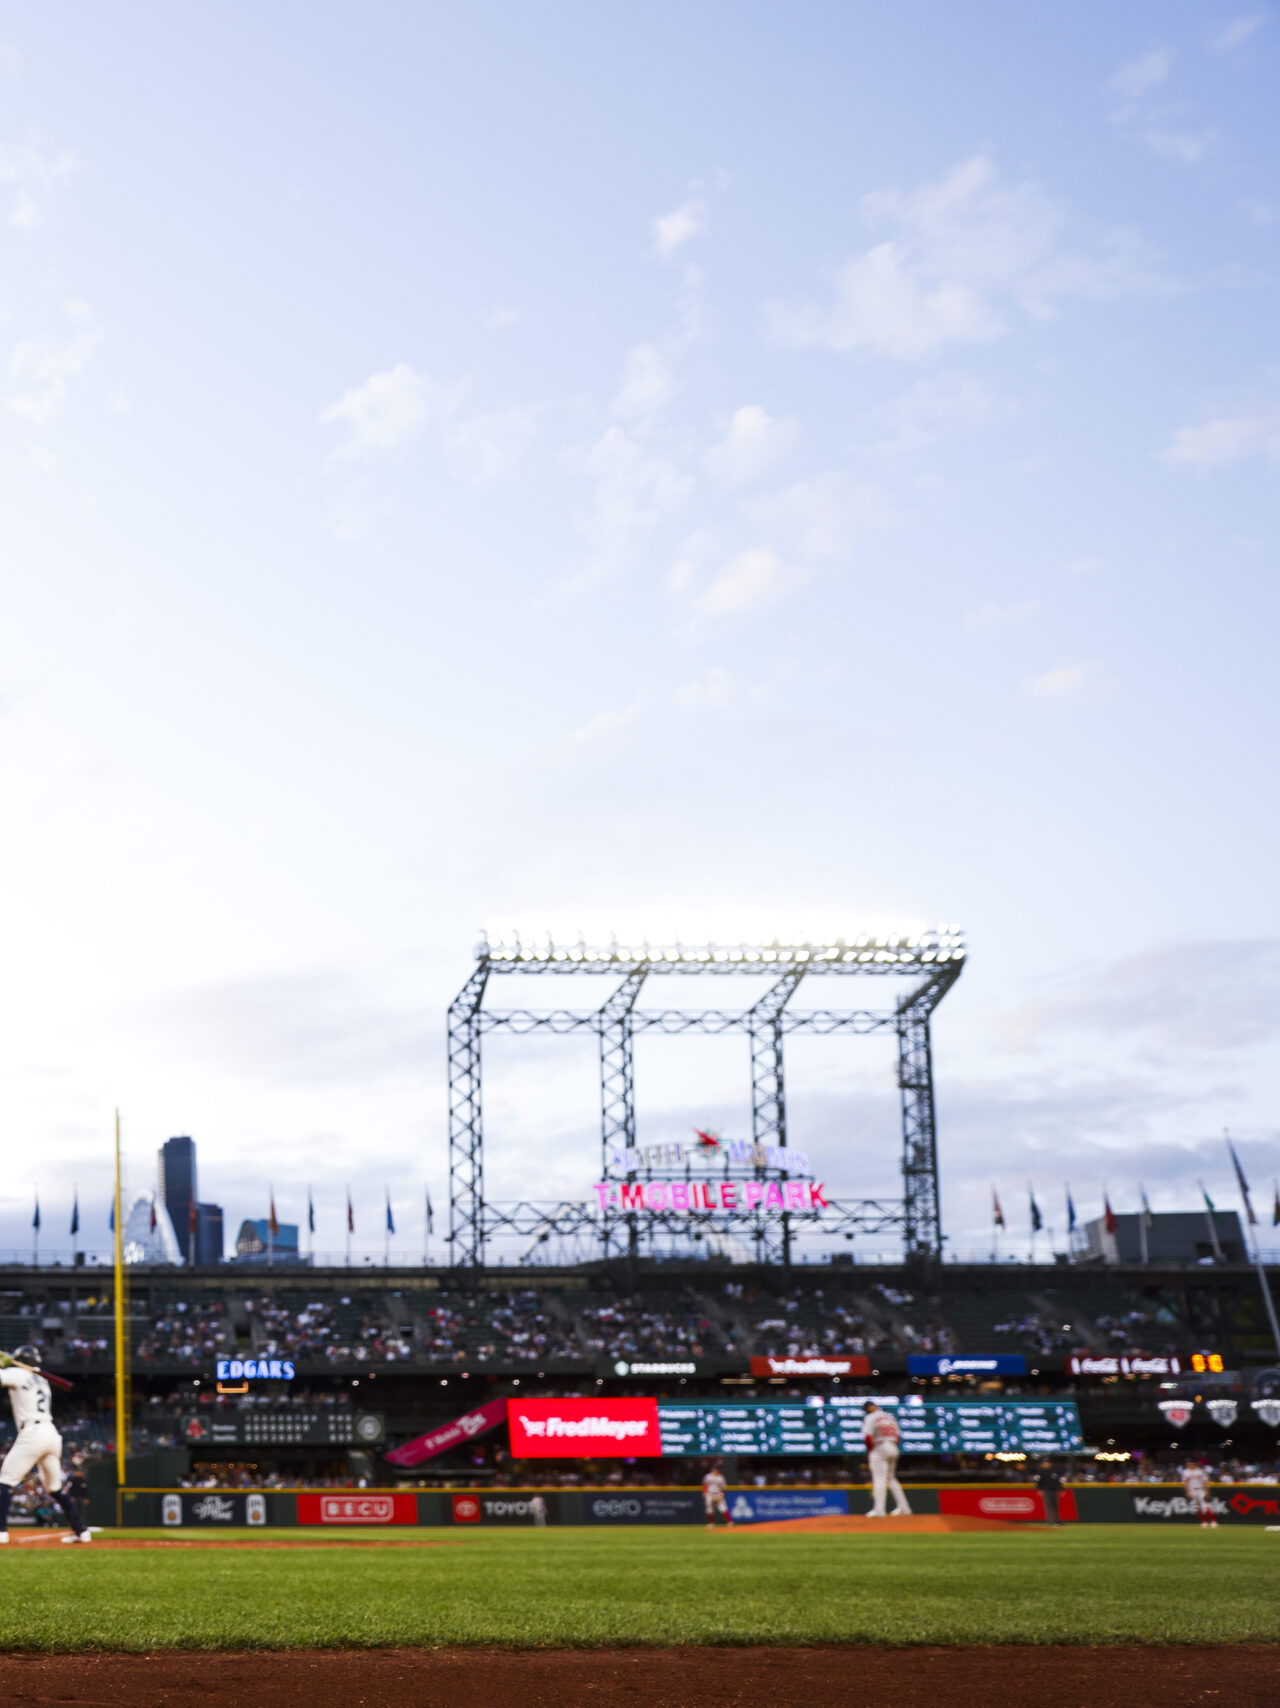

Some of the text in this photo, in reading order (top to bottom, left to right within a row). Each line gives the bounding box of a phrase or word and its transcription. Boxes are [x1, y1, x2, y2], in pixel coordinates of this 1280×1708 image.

[593, 1181, 829, 1210] T-MOBILE PARK
[327, 1502, 387, 1516] BECU
[483, 1501, 531, 1516] TOYO
